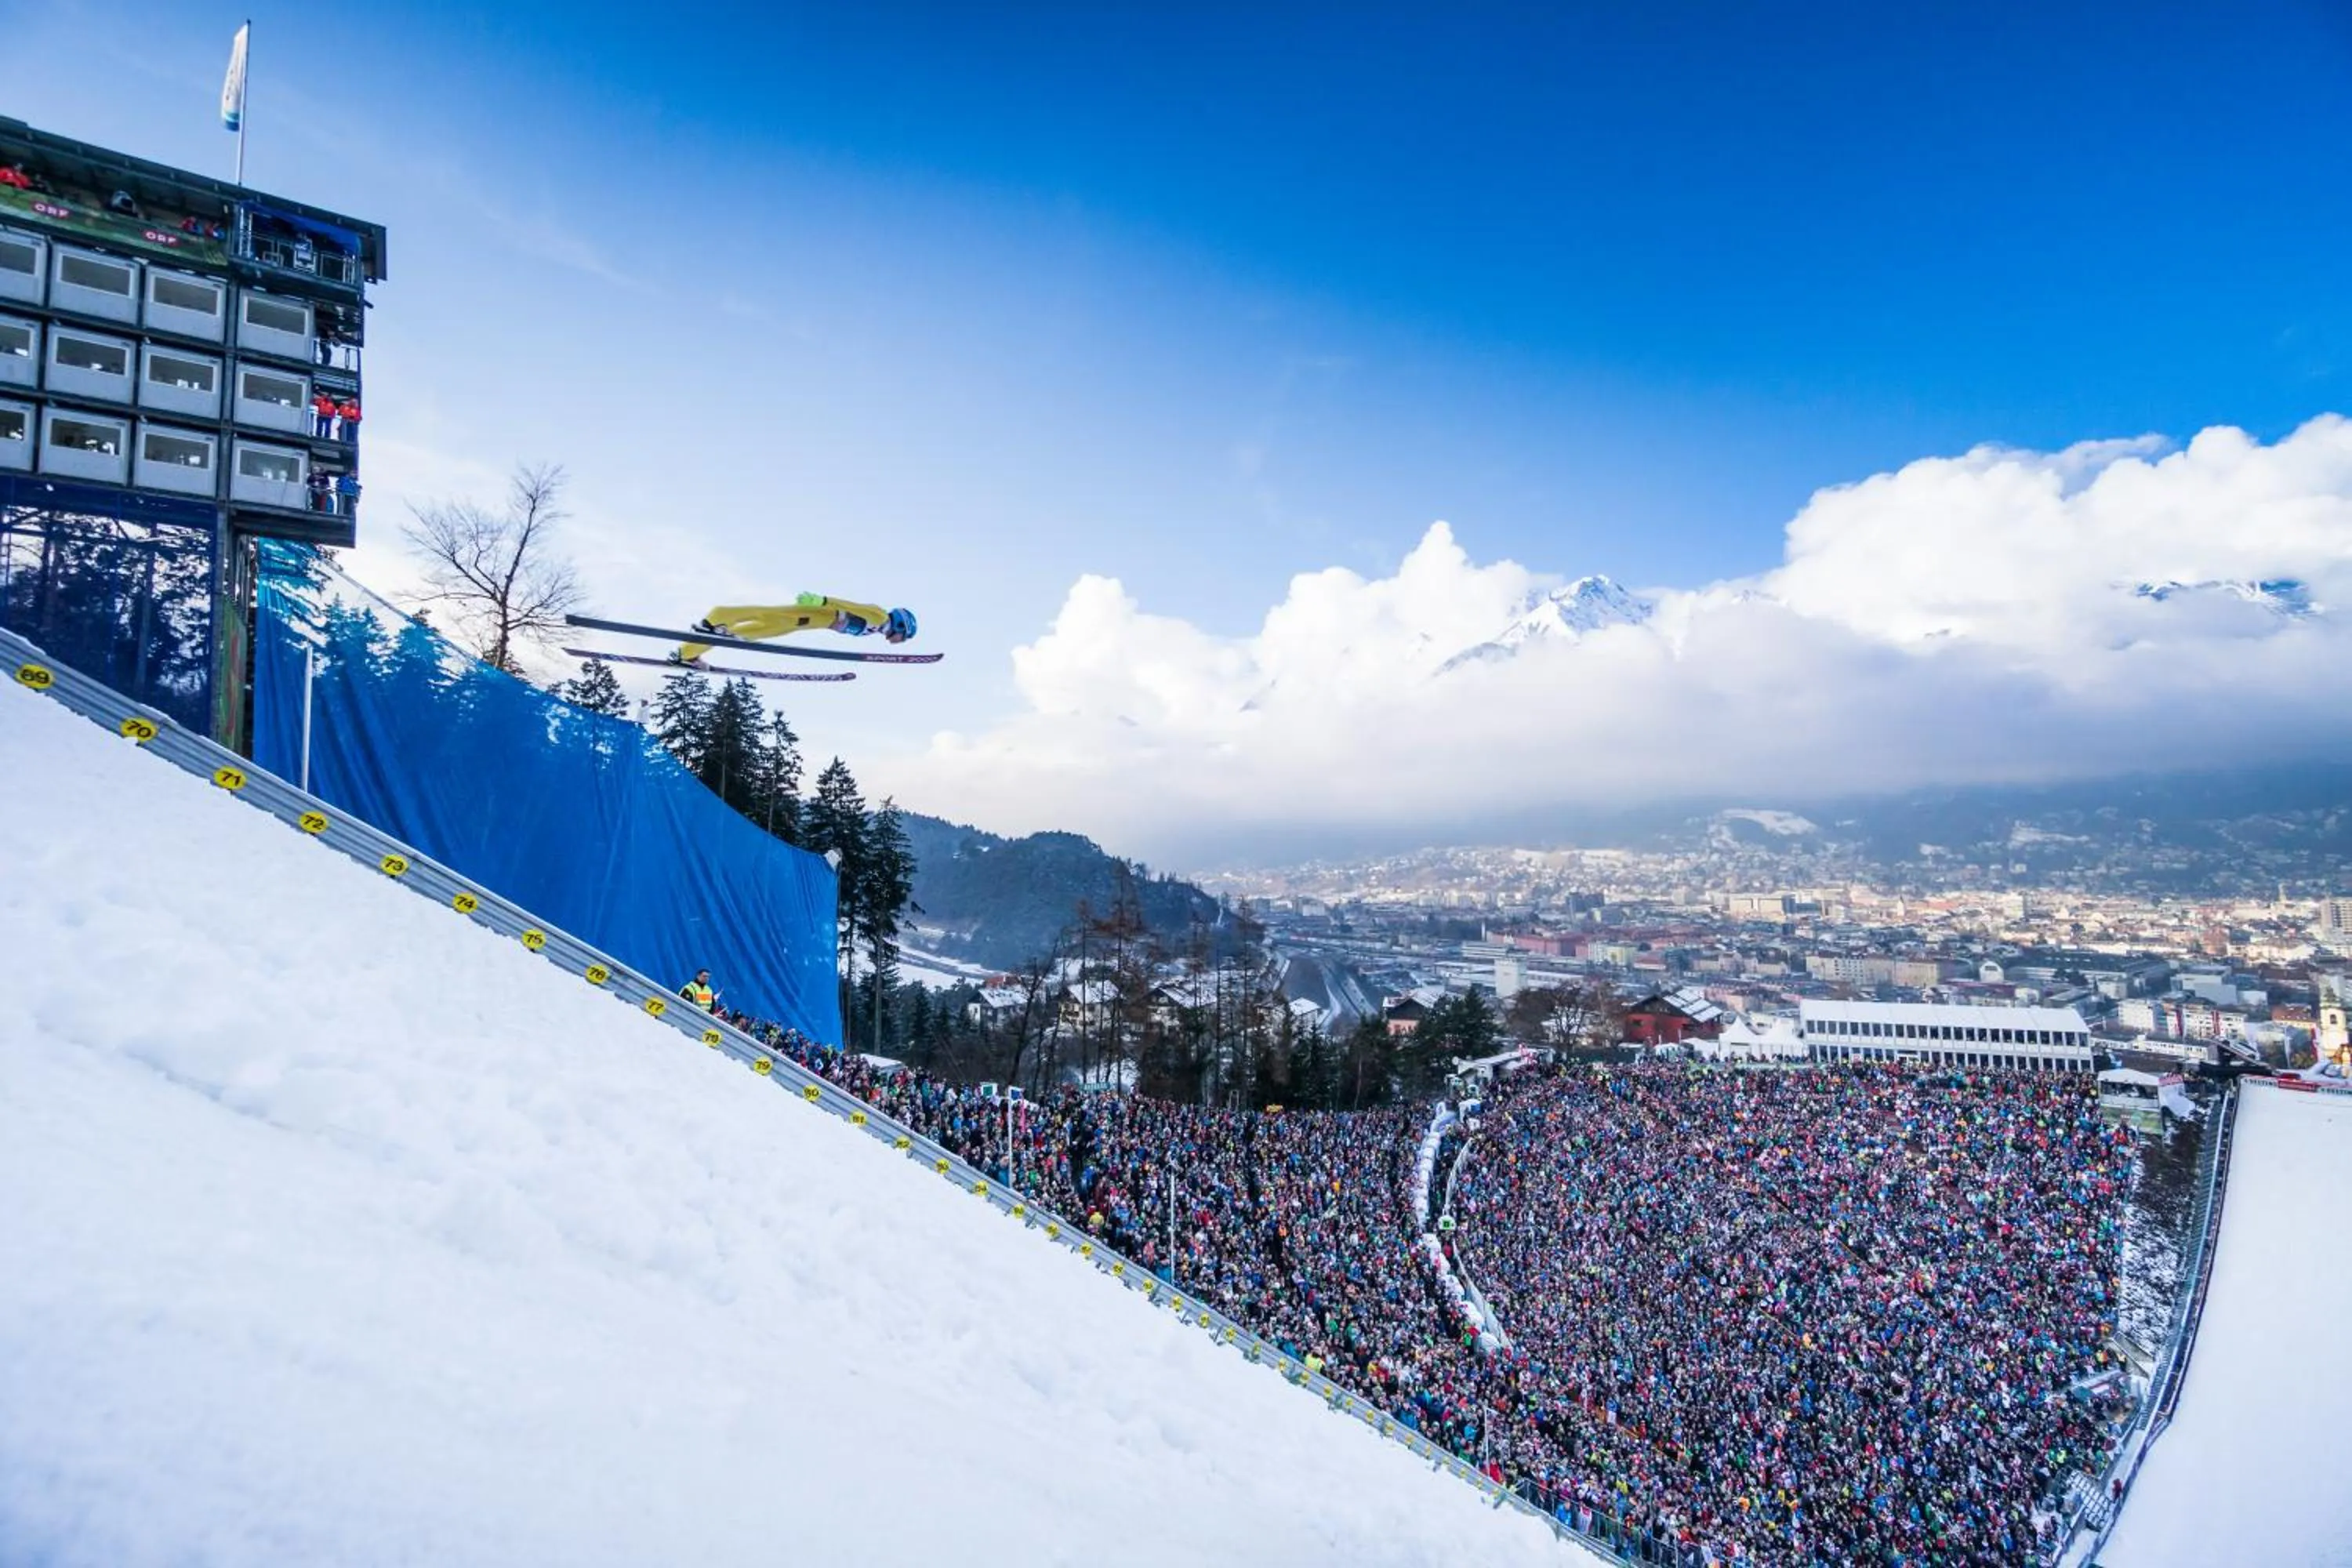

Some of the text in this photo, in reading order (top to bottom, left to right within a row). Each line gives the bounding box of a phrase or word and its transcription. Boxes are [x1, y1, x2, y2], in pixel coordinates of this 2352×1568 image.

[34, 203, 70, 218] ORF
[144, 230, 177, 244] ORF
[21, 669, 49, 684] 69
[125, 720, 151, 738] 70
[222, 771, 241, 786] 71
[303, 815, 325, 830] 72
[384, 858, 405, 871] 73
[456, 895, 474, 909] 74
[526, 933, 543, 944] 75
[589, 967, 606, 980] 76
[647, 1000, 663, 1011] 77
[756, 1061, 771, 1072] 79
